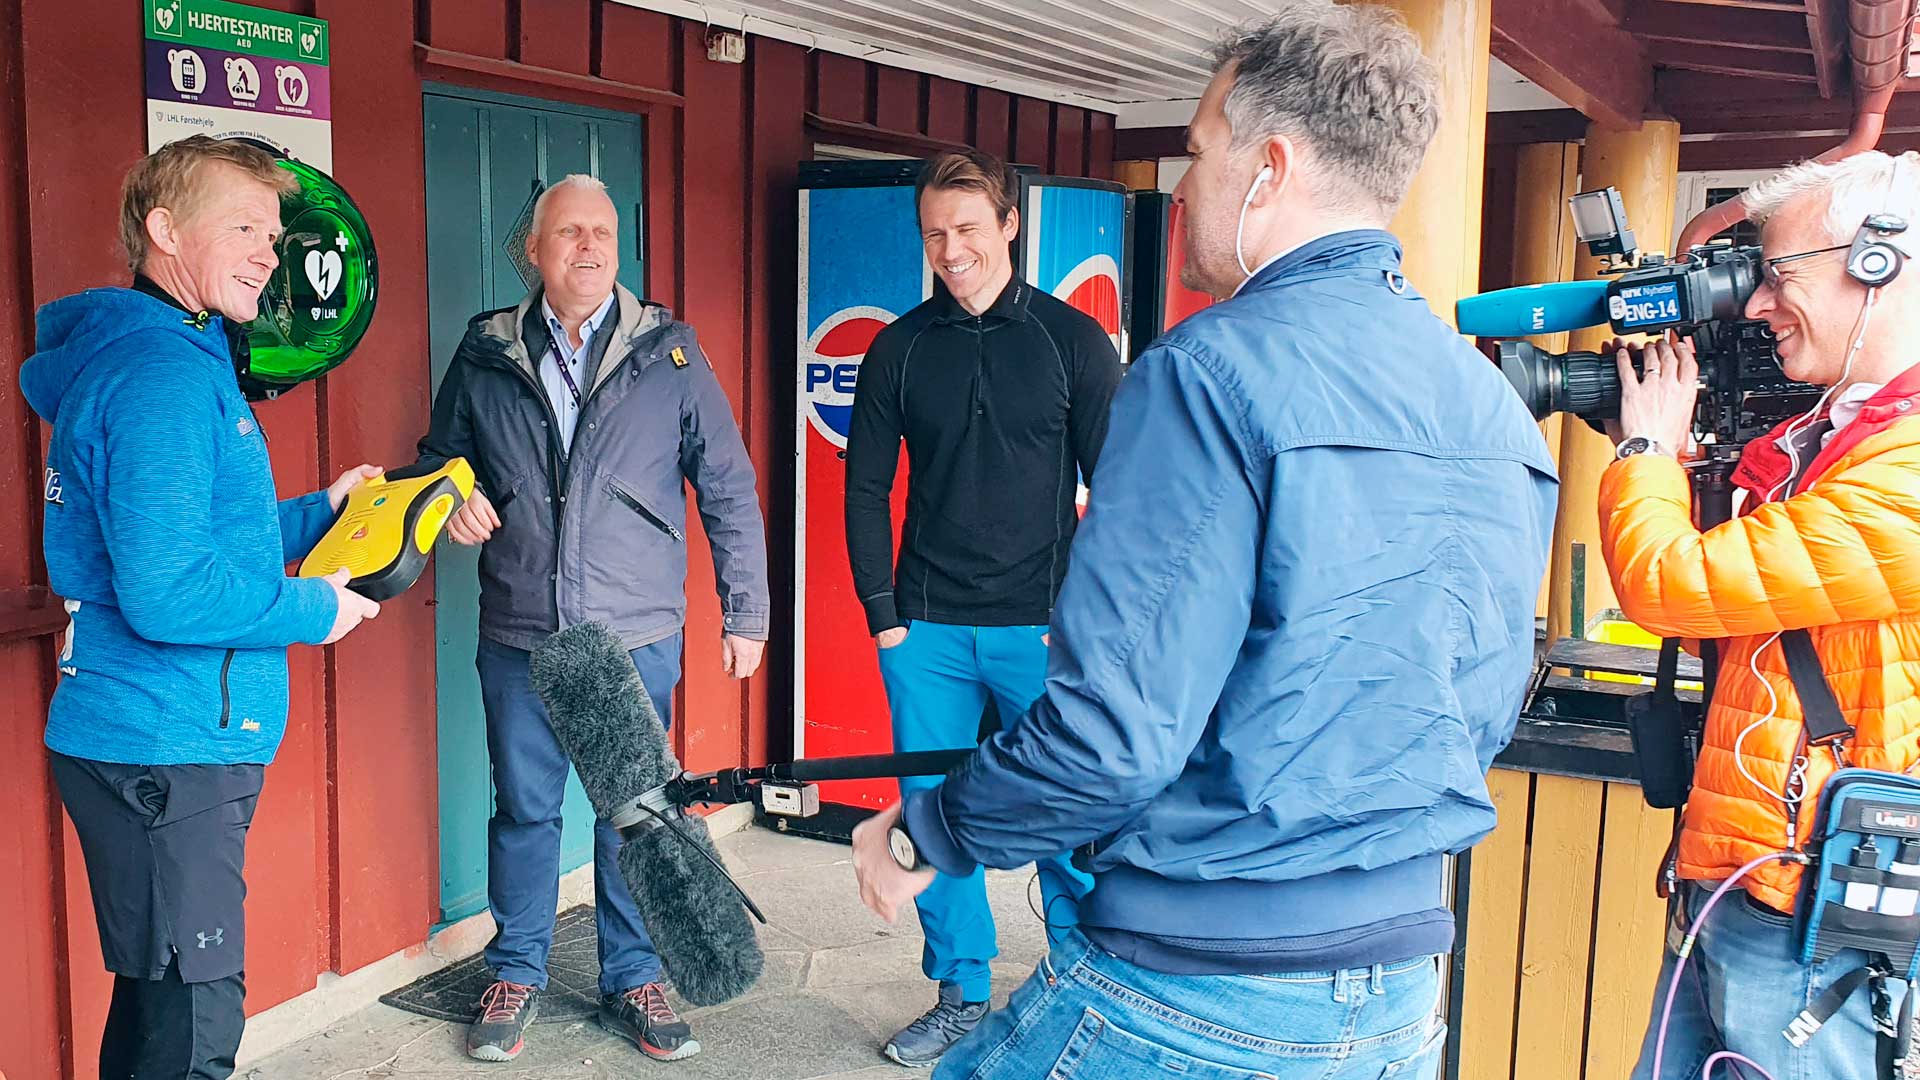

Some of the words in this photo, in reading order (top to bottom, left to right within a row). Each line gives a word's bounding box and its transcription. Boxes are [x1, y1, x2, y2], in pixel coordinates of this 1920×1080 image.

[187, 10, 294, 45] HJERTESTARTER
[236, 38, 252, 49] AED
[167, 114, 179, 123] LHL
[324, 308, 338, 319] LHL
[1532, 306, 1545, 330] NRK
[1625, 299, 1678, 322] ENG-14
[806, 363, 858, 394] PE
